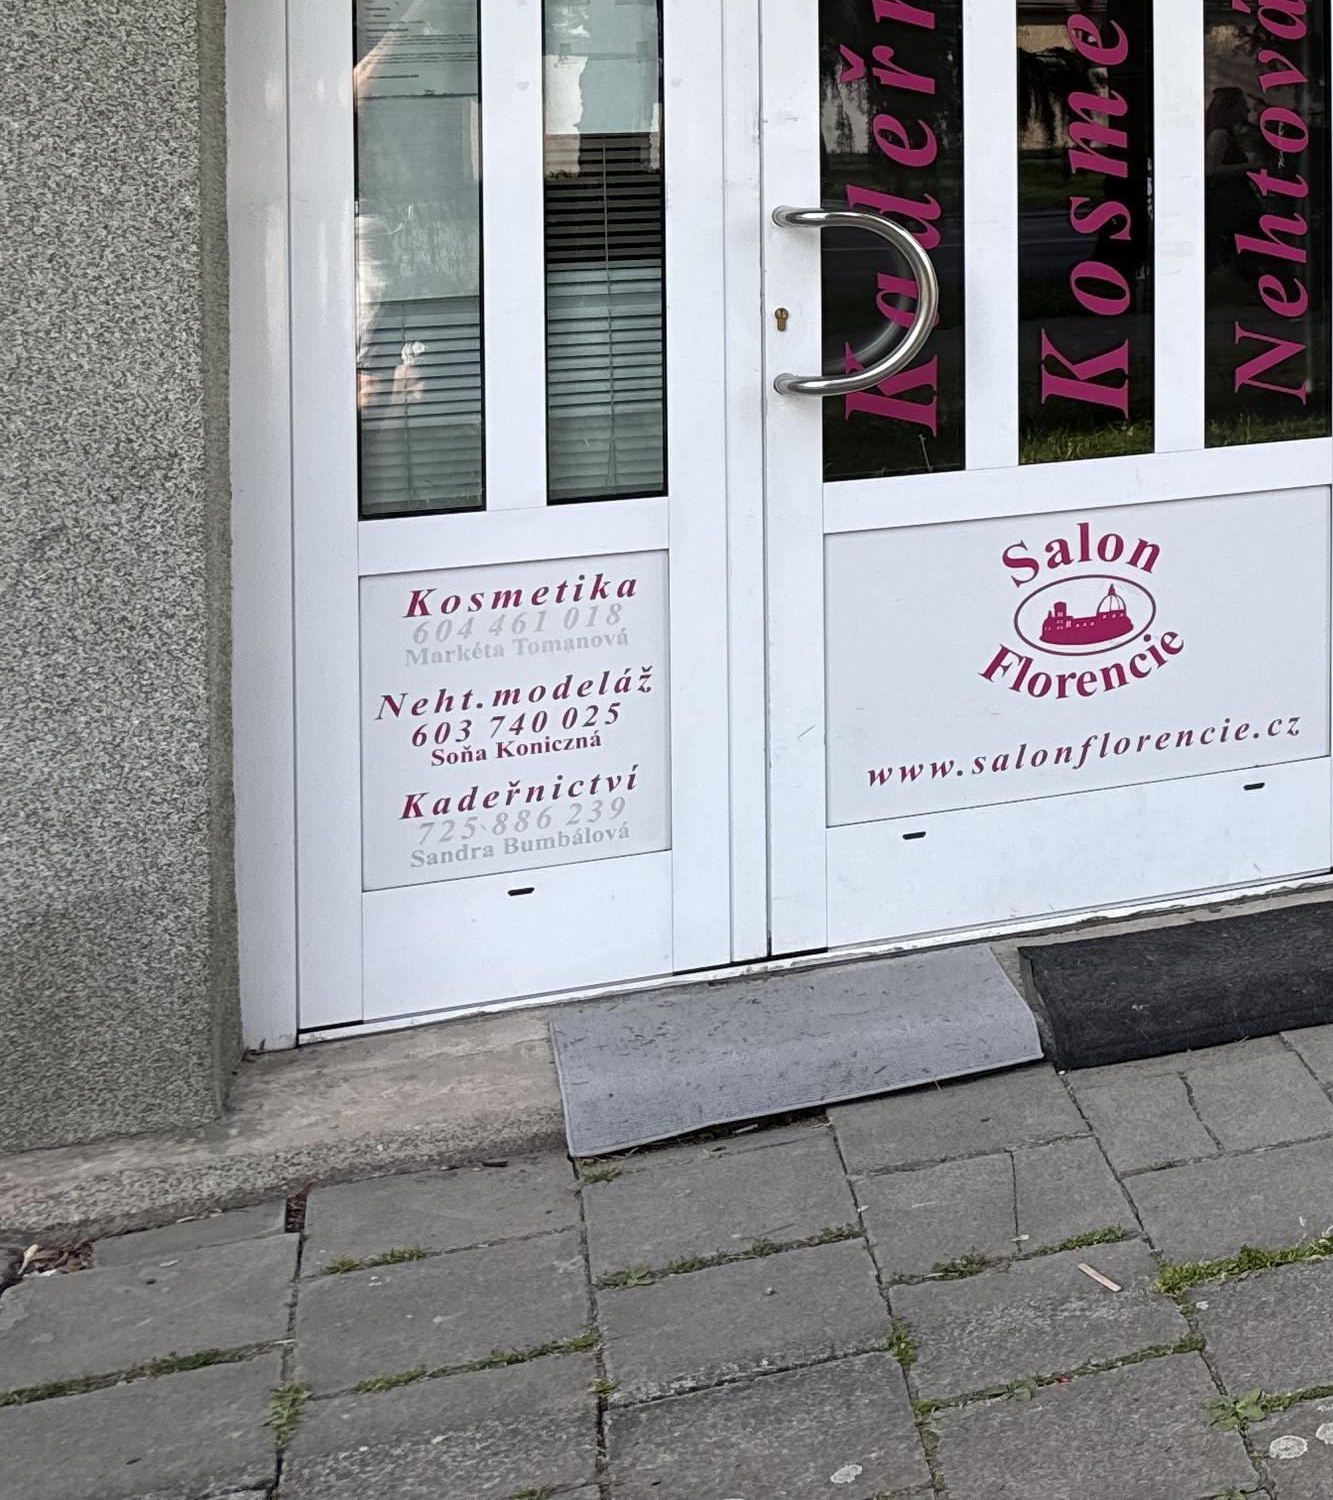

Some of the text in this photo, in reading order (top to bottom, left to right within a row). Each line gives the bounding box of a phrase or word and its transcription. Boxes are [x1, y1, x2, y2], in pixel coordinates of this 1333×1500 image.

[1001, 522, 1161, 588] Salon
[403, 573, 637, 618] Kosmetika
[405, 627, 628, 667] Markéta Tomanová
[413, 602, 622, 645] 604 461 018
[977, 629, 1185, 699] Florencie
[412, 702, 621, 748] 603 740 025
[431, 730, 602, 767] Soňa Koniczná
[867, 715, 1301, 787] www.salonflorencie.cz
[400, 764, 639, 821] Kadeřnictví
[419, 796, 627, 846] 725 886 239
[410, 822, 630, 869] Sandra Bumbálová
